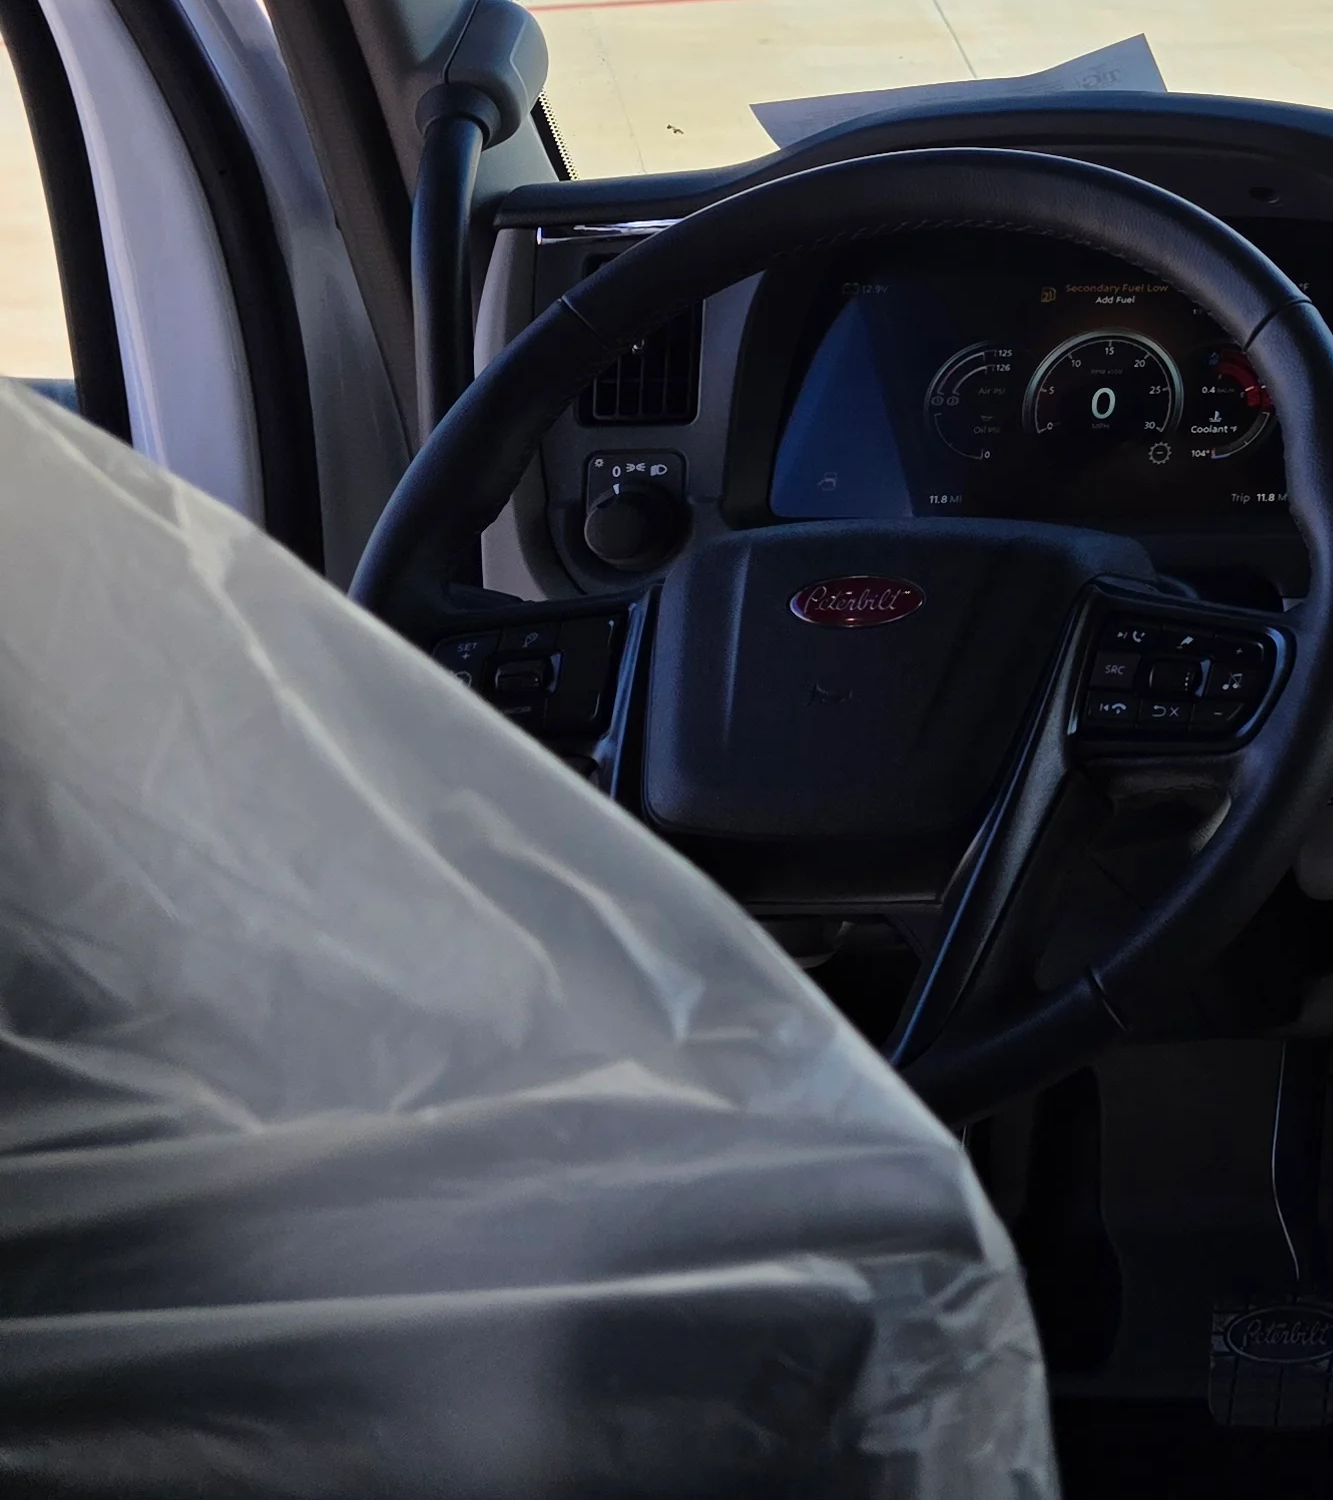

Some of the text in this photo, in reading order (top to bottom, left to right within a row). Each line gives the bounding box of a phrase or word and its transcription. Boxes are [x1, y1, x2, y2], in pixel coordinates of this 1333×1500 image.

[1065, 283, 1169, 294] Secondary Fuel Low
[1095, 296, 1136, 304] Add Fuel
[998, 349, 1013, 357] 125
[1105, 347, 1115, 355] 15
[995, 364, 1011, 372] 126
[1071, 359, 1146, 368] 10 20
[977, 386, 991, 395] Air
[1049, 386, 1162, 394] 5 25
[1202, 386, 1216, 394] 0.4
[1091, 387, 1116, 420] 0
[972, 425, 986, 434] Oil
[1143, 422, 1156, 430] 30
[1190, 425, 1228, 434] Coolant
[984, 451, 991, 459] 0
[929, 495, 963, 504] 11.8 MI
[1231, 494, 1276, 503] Trip 11.8
[804, 586, 904, 612] Peterbilt
[457, 642, 477, 651] SET
[1104, 664, 1126, 675] SRC
